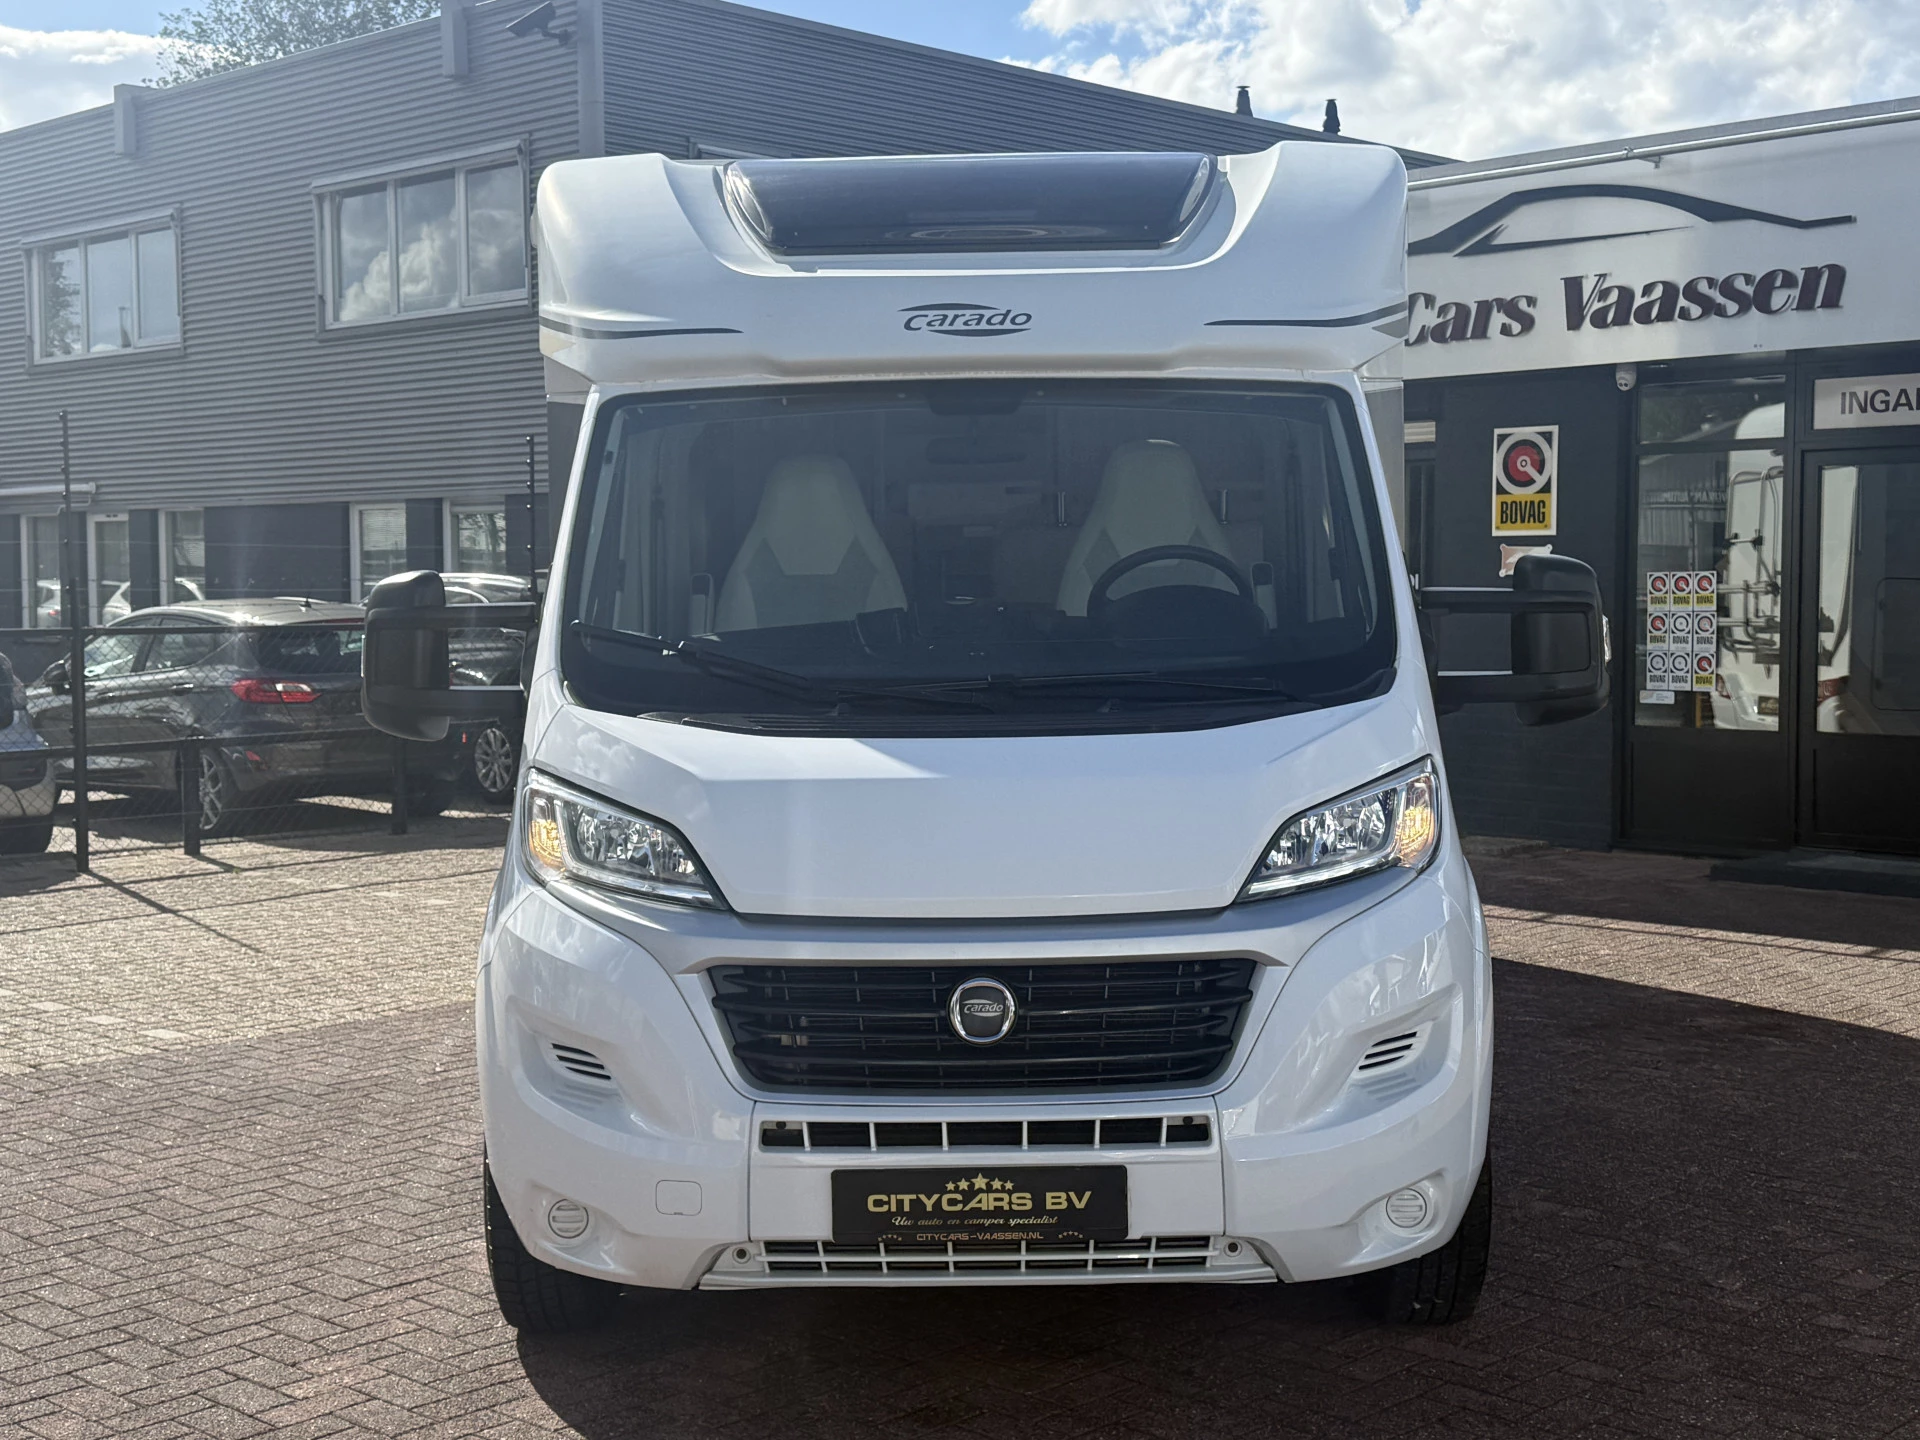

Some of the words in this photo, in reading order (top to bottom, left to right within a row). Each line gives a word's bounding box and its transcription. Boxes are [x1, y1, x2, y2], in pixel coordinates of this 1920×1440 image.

[1405, 292, 1538, 346] Cars
[1560, 263, 1847, 331] Vaassen
[904, 309, 1032, 331] carado
[1841, 387, 1920, 414] INGA
[1500, 500, 1546, 524] BOVAG
[964, 1003, 1004, 1014] carado
[867, 1192, 1033, 1213] CITYCARS
[1045, 1191, 1092, 1210] BV
[892, 1216, 914, 1226] Uw
[918, 1218, 943, 1226] auto
[964, 1217, 1006, 1227] camper
[1007, 1215, 1058, 1227] specialist
[916, 1232, 1044, 1241] CITYCARS-VAASSEN.NL
